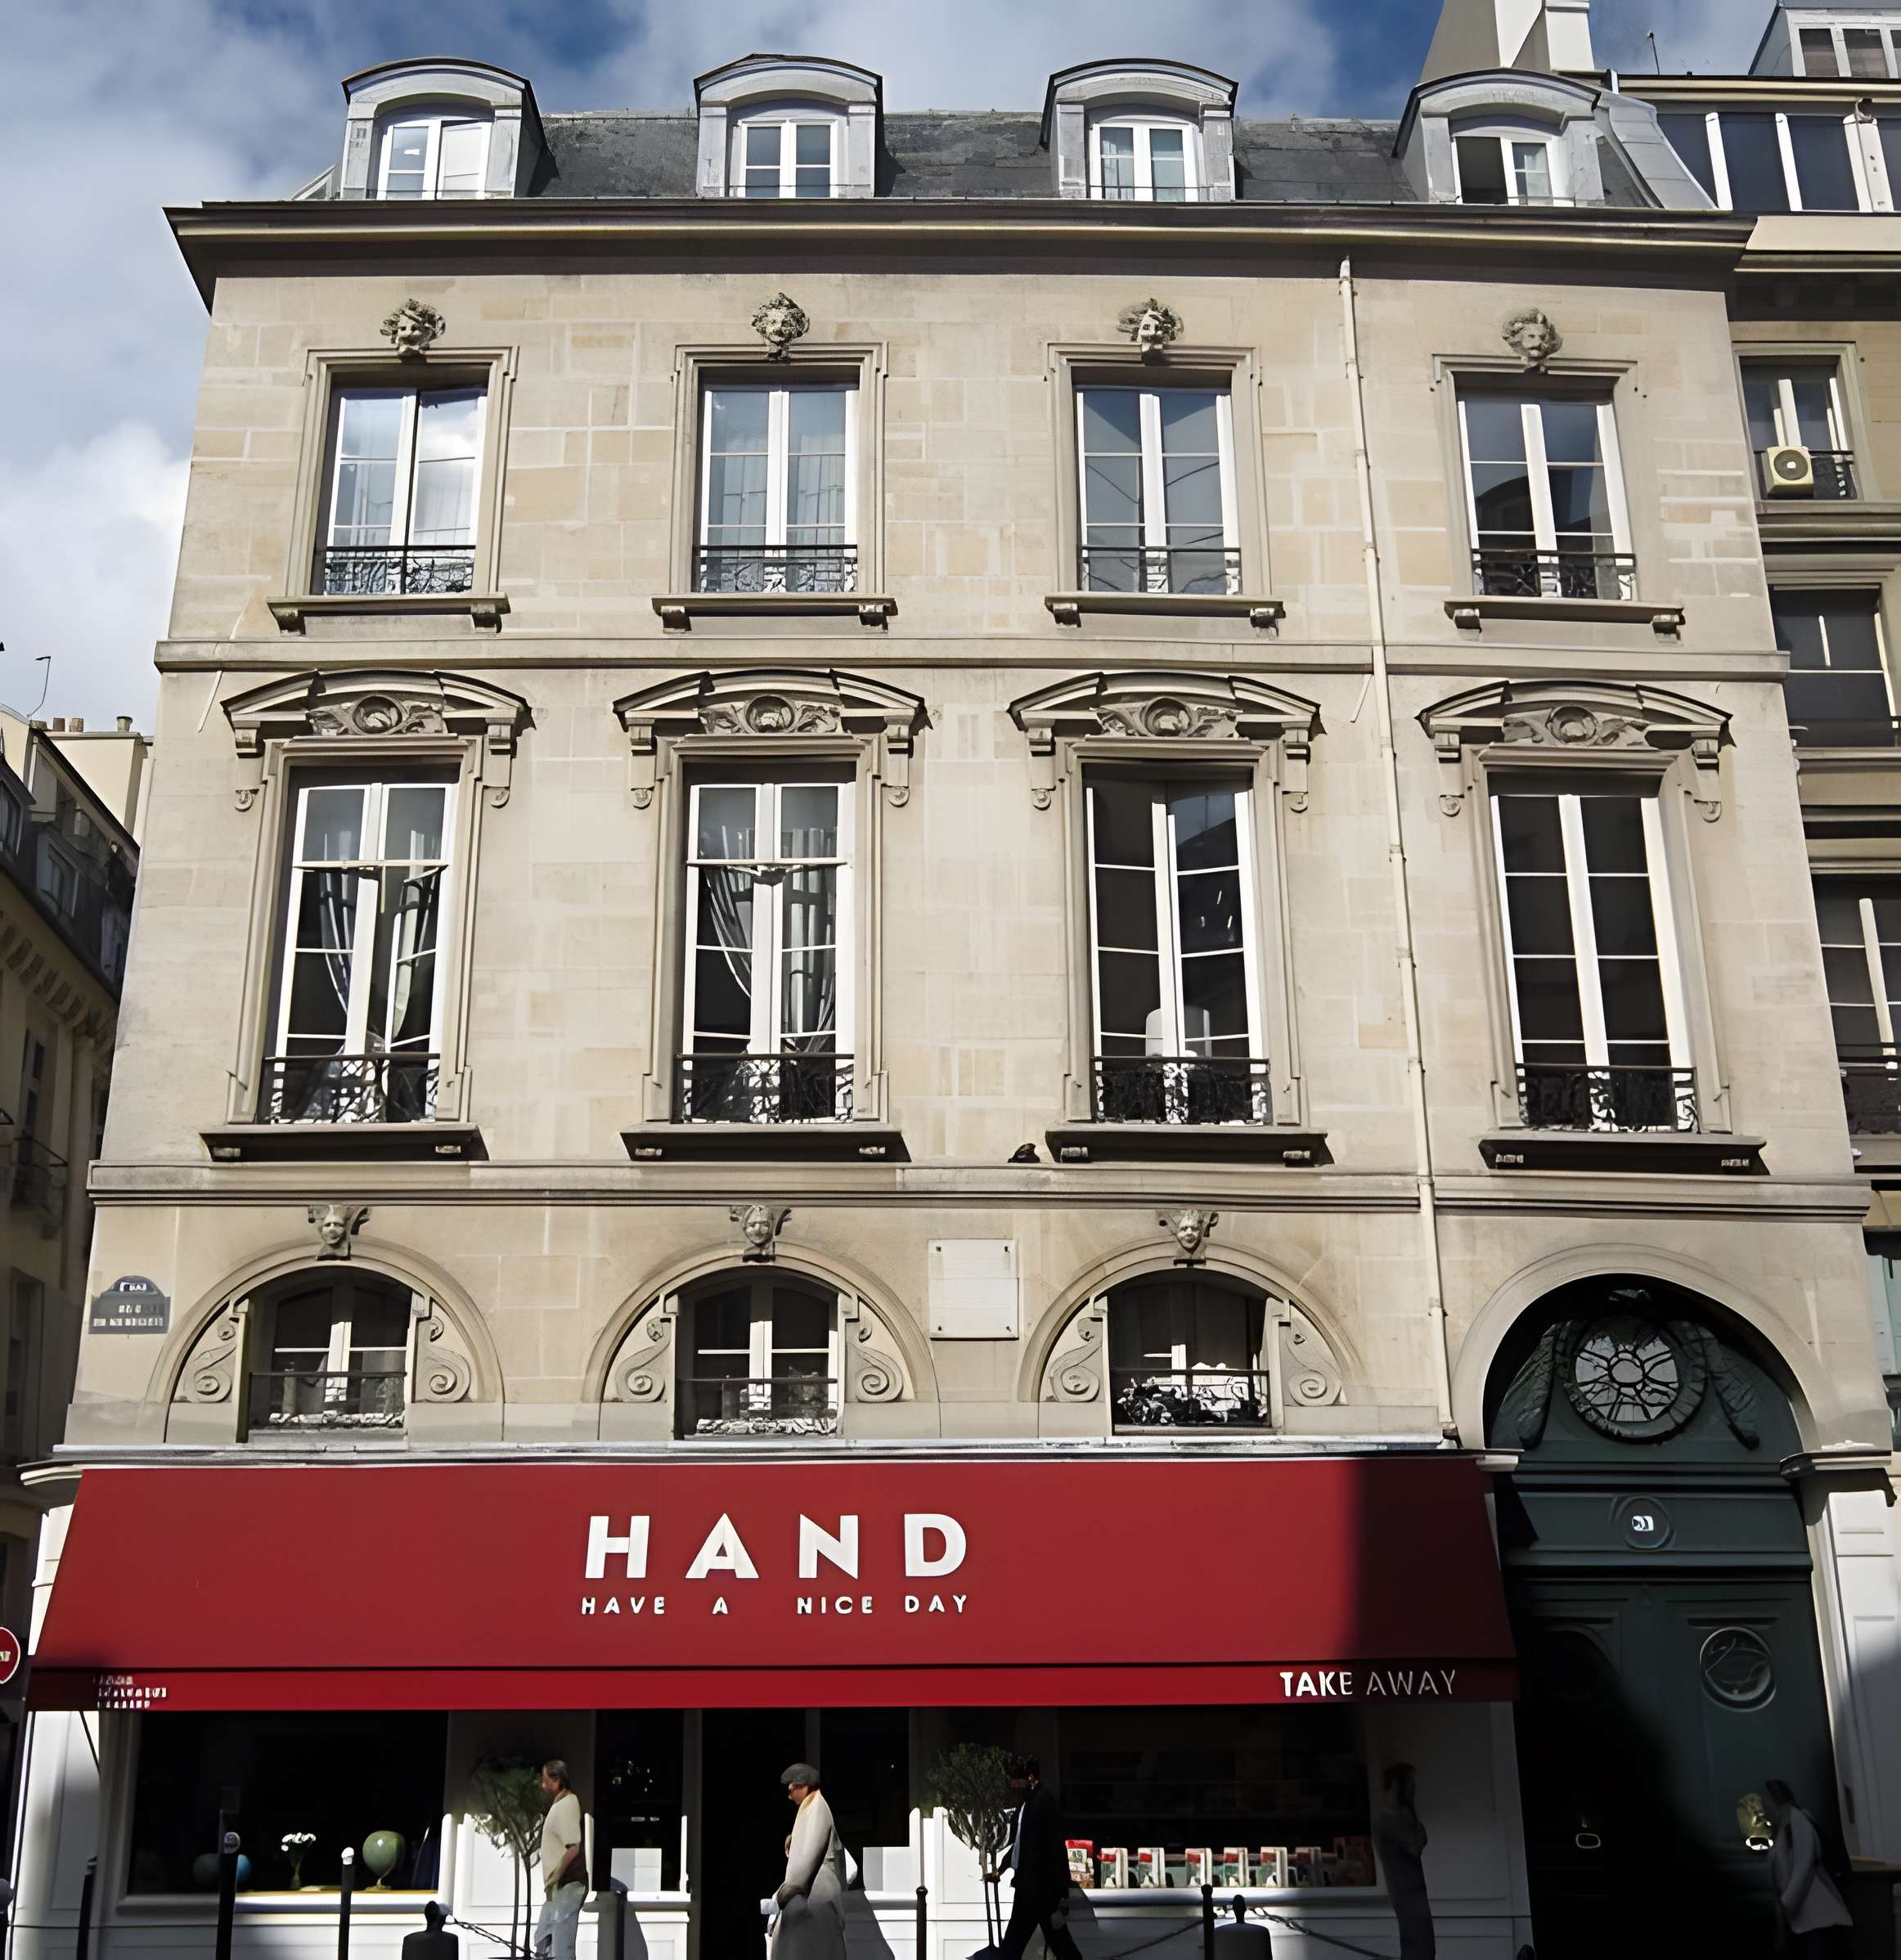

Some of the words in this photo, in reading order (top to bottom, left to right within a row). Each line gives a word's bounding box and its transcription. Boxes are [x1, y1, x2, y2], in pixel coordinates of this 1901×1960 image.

[585, 1513, 967, 1580] HAND
[581, 1596, 665, 1615] HAVE
[712, 1596, 729, 1615] A
[797, 1595, 873, 1615] NICE
[904, 1594, 967, 1613] DAY
[1279, 1670, 1353, 1697] TAKE
[1366, 1669, 1455, 1696] AWAY
